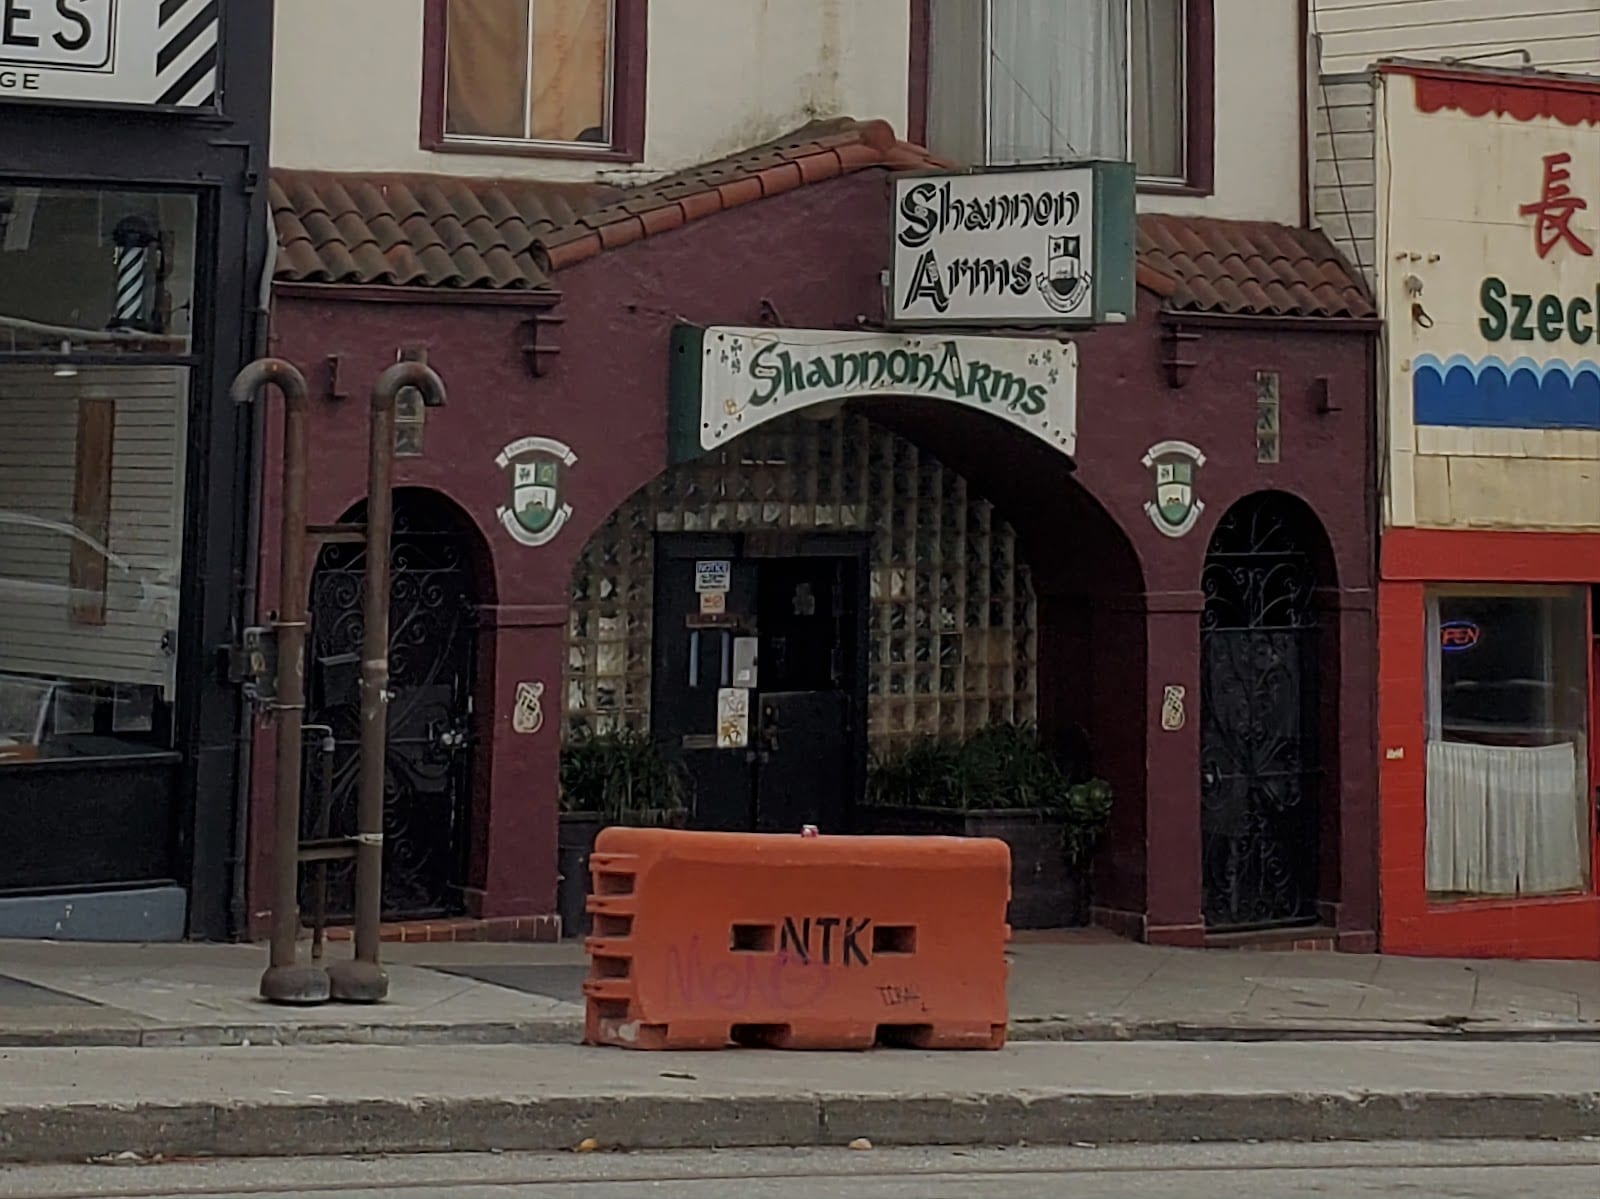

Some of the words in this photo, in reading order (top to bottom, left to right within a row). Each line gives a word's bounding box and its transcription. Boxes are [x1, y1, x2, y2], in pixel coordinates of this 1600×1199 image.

[0, 72, 40, 90] GE
[898, 181, 1079, 247] Shannon
[1519, 153, 1593, 259] 長
[903, 249, 1032, 312] Arms
[1479, 277, 1600, 344] Szec
[749, 341, 932, 407] Shannon
[780, 916, 871, 967] NTK
